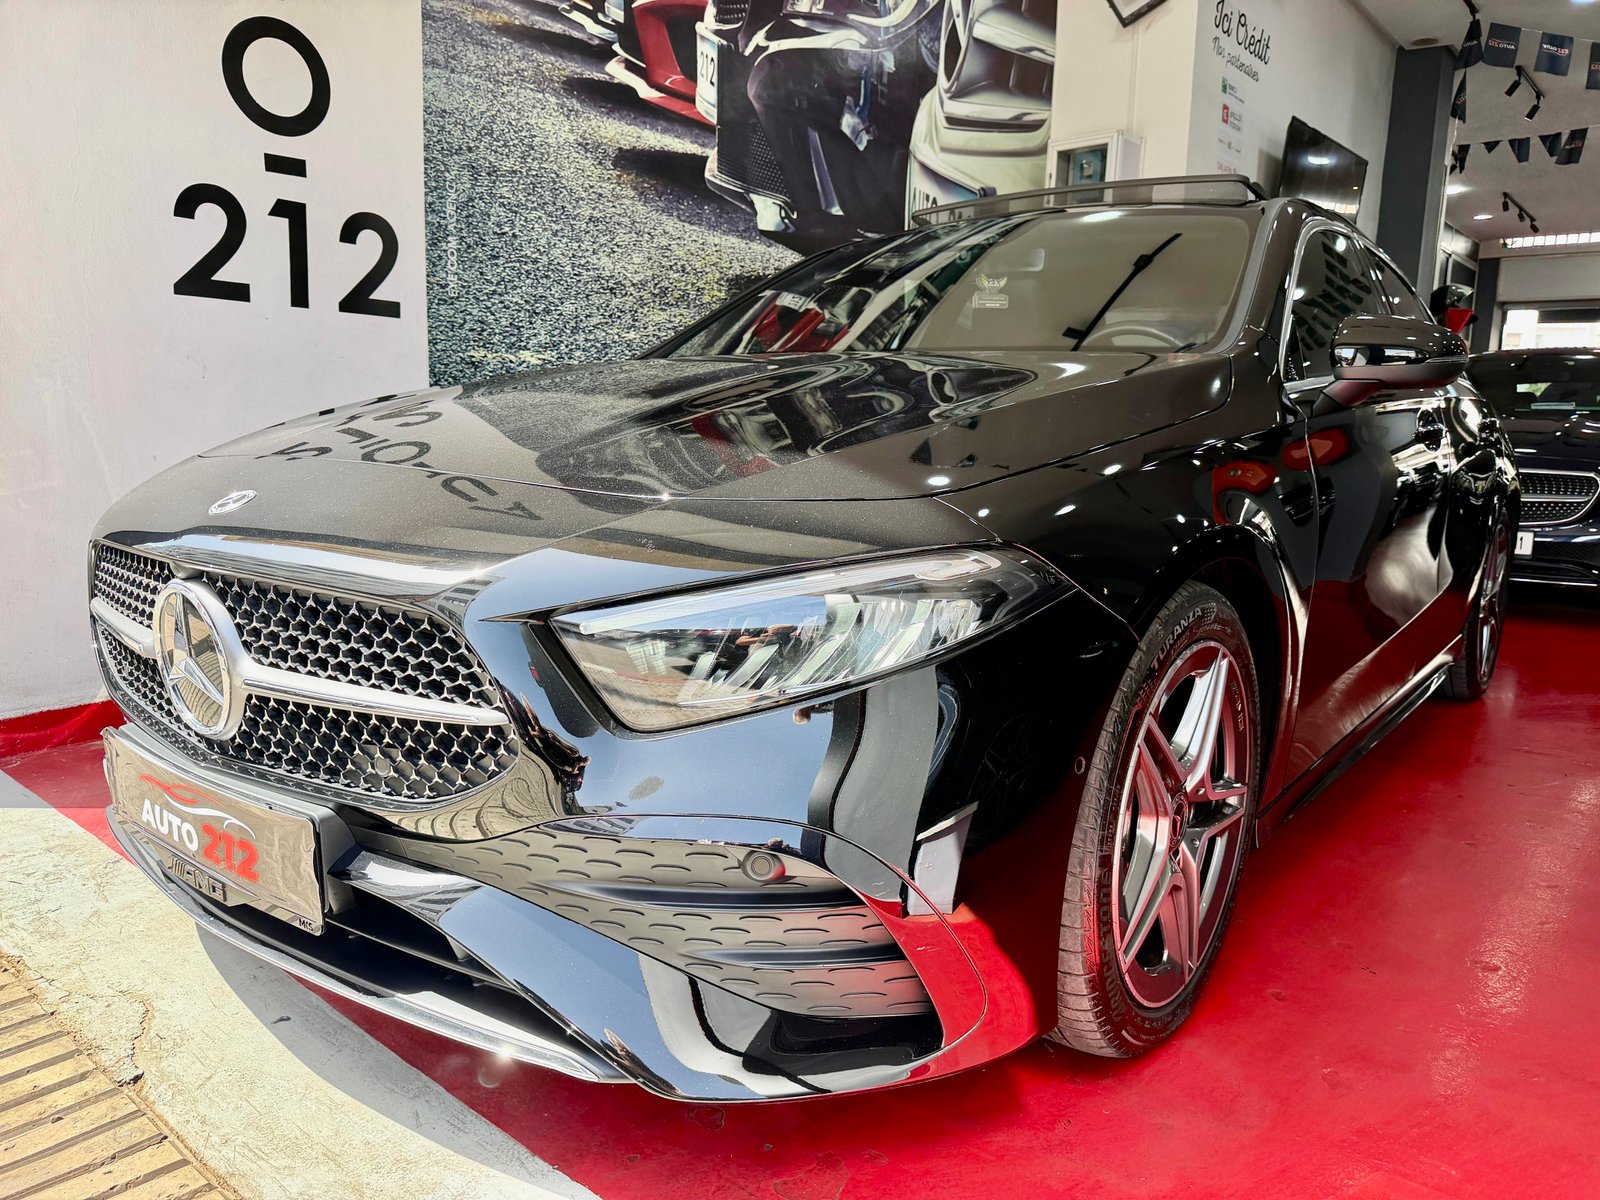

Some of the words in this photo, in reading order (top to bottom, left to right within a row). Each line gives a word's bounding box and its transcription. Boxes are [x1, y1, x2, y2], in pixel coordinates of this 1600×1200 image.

[699, 50, 716, 87] 212
[1236, 10, 1270, 65] Crédit
[446, 172, 458, 234] AGENCY
[173, 183, 401, 319] 212
[447, 235, 459, 273] COM
[1150, 606, 1203, 671] TURANZA
[141, 798, 199, 852] AUTO
[201, 822, 259, 883] 212
